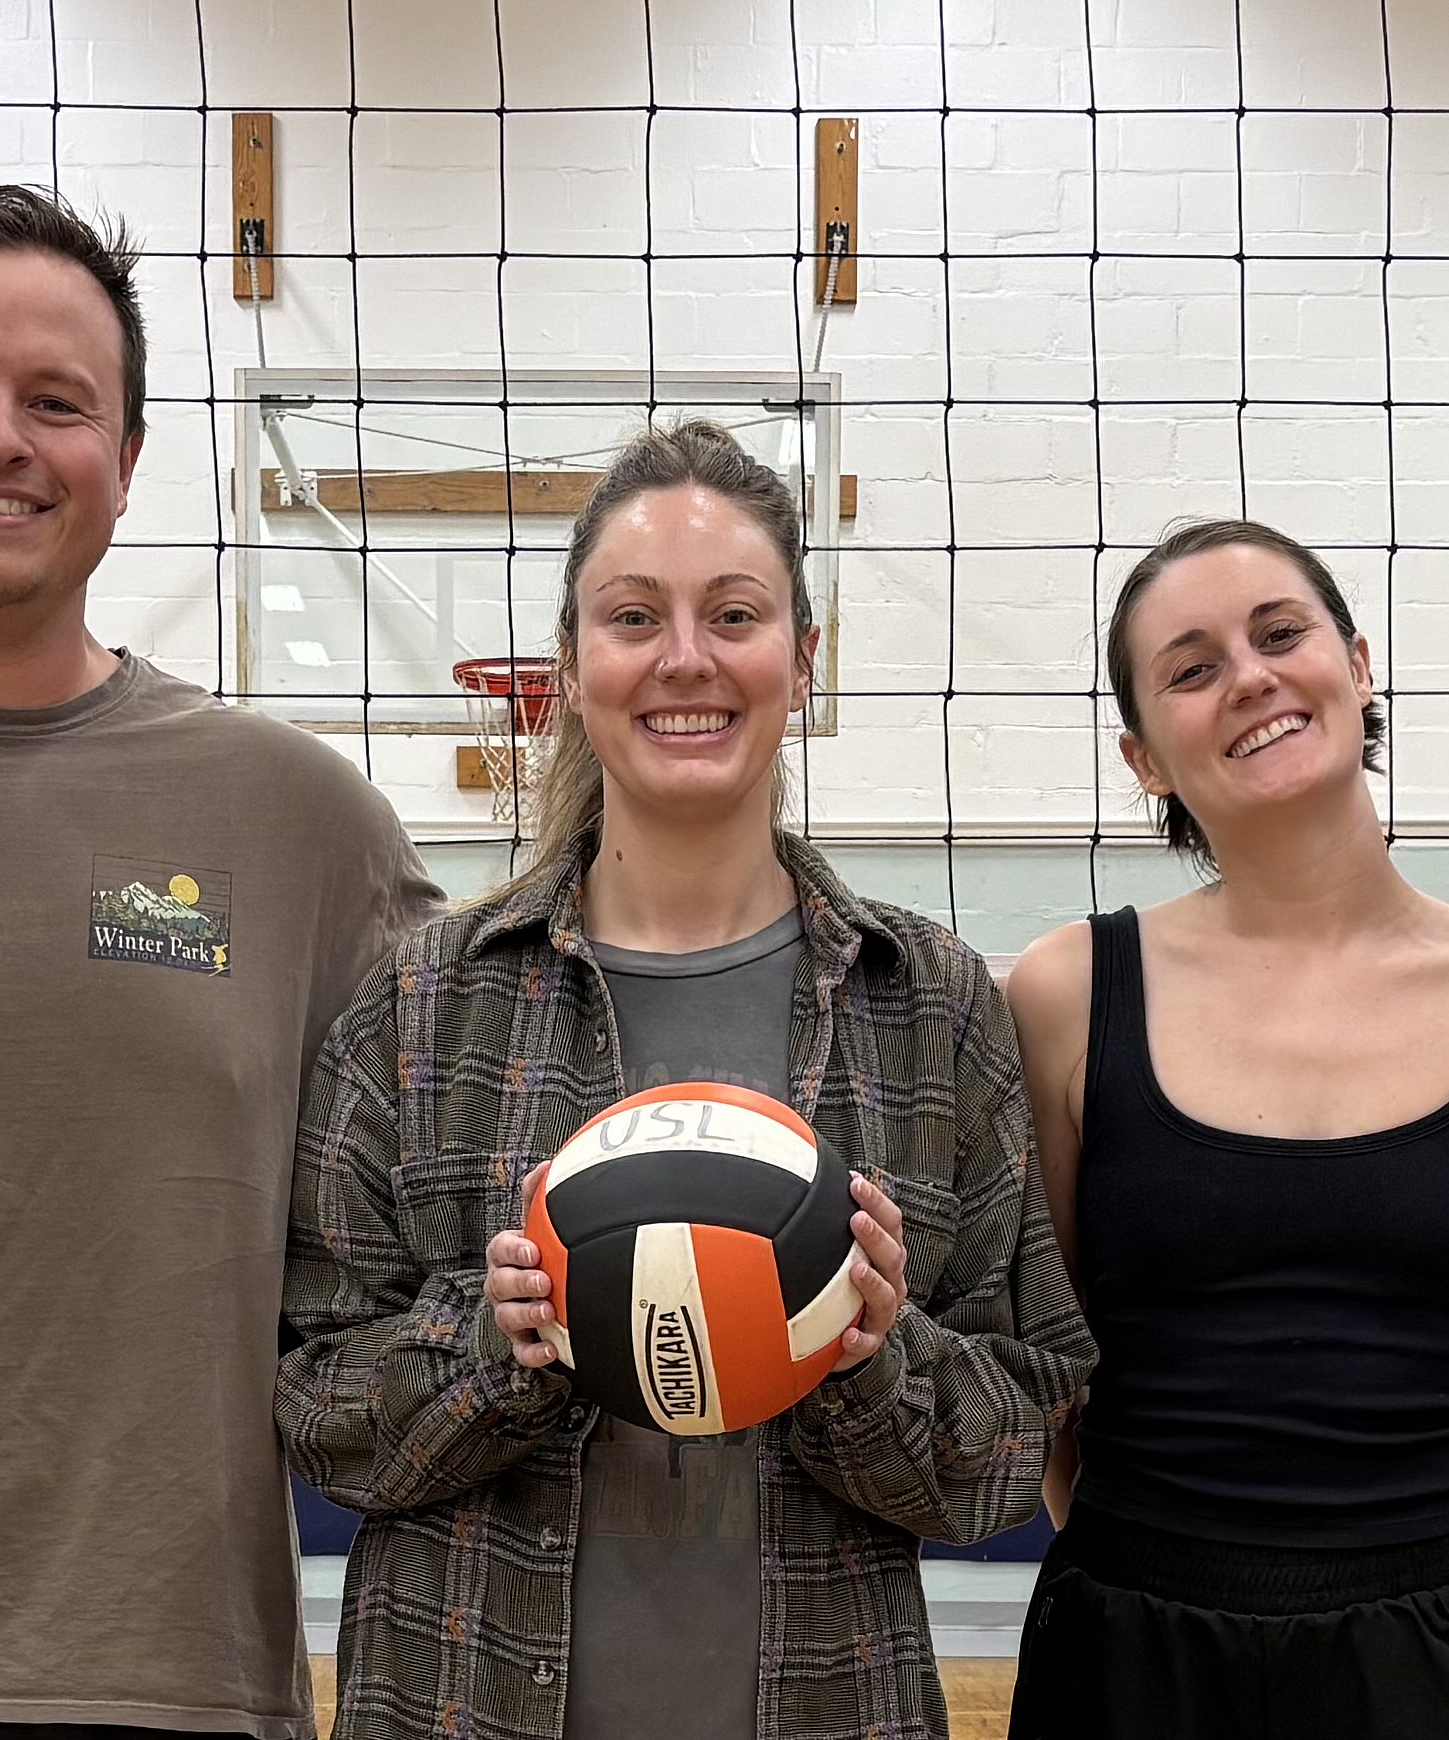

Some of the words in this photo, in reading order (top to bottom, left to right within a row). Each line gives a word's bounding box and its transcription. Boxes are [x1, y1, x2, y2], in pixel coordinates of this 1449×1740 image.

[94, 926, 164, 953] Winter
[170, 936, 210, 962] Park
[600, 1103, 735, 1151] USL
[656, 1311, 696, 1420] TACHIKARA
